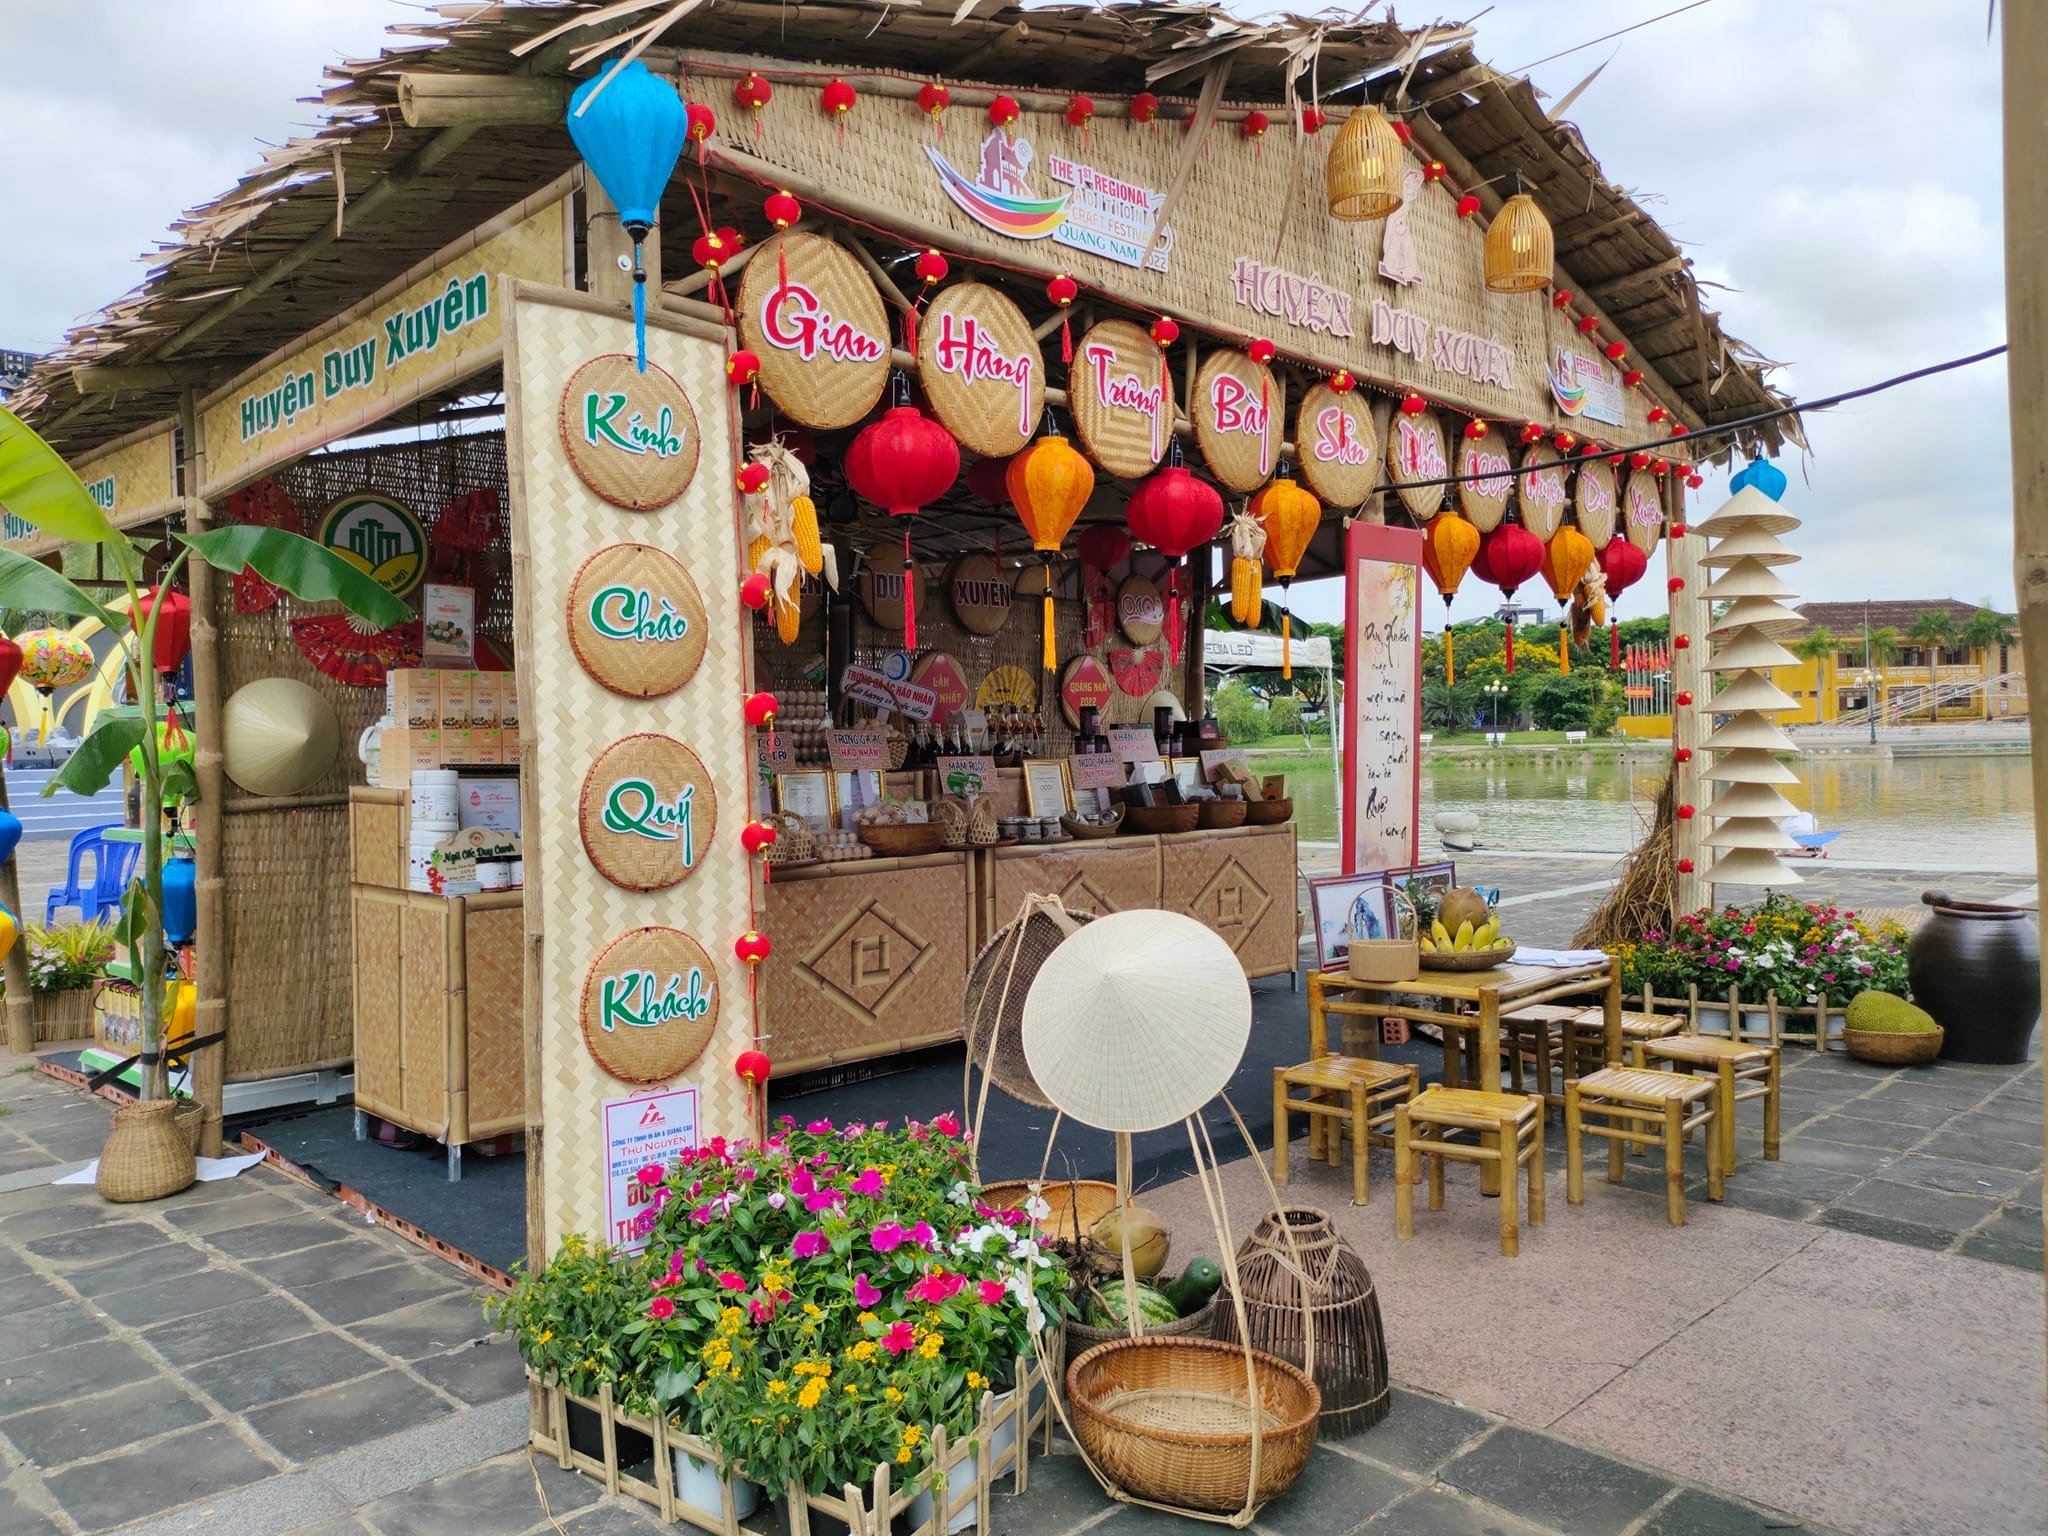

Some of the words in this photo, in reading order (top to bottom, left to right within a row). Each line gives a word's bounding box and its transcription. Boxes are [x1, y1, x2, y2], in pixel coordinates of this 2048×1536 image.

[1051, 157, 1074, 181] THE
[1094, 174, 1149, 209] REGIONAL
[1108, 220, 1152, 246] FESTIVA
[1110, 240, 1138, 262] NAM
[763, 284, 883, 359] Gian
[1232, 258, 1354, 338] HUYỆN
[1372, 300, 1429, 361] DUY
[1434, 333, 1514, 391] XUYÊN
[241, 371, 316, 442] Huyện
[323, 336, 377, 400] Duy
[385, 272, 489, 369] Xuyên
[937, 313, 1031, 436] Hàng
[586, 392, 685, 456] Kính
[590, 585, 688, 642] Chào
[875, 572, 907, 601] DU
[955, 576, 1011, 608] XUYÊN
[1205, 643, 1229, 656] EDIA
[1231, 644, 1253, 656] LED
[1080, 696, 1097, 707] 2022
[603, 779, 695, 867] Quý
[602, 968, 712, 1031] Khách
[621, 1146, 643, 1156] THU
